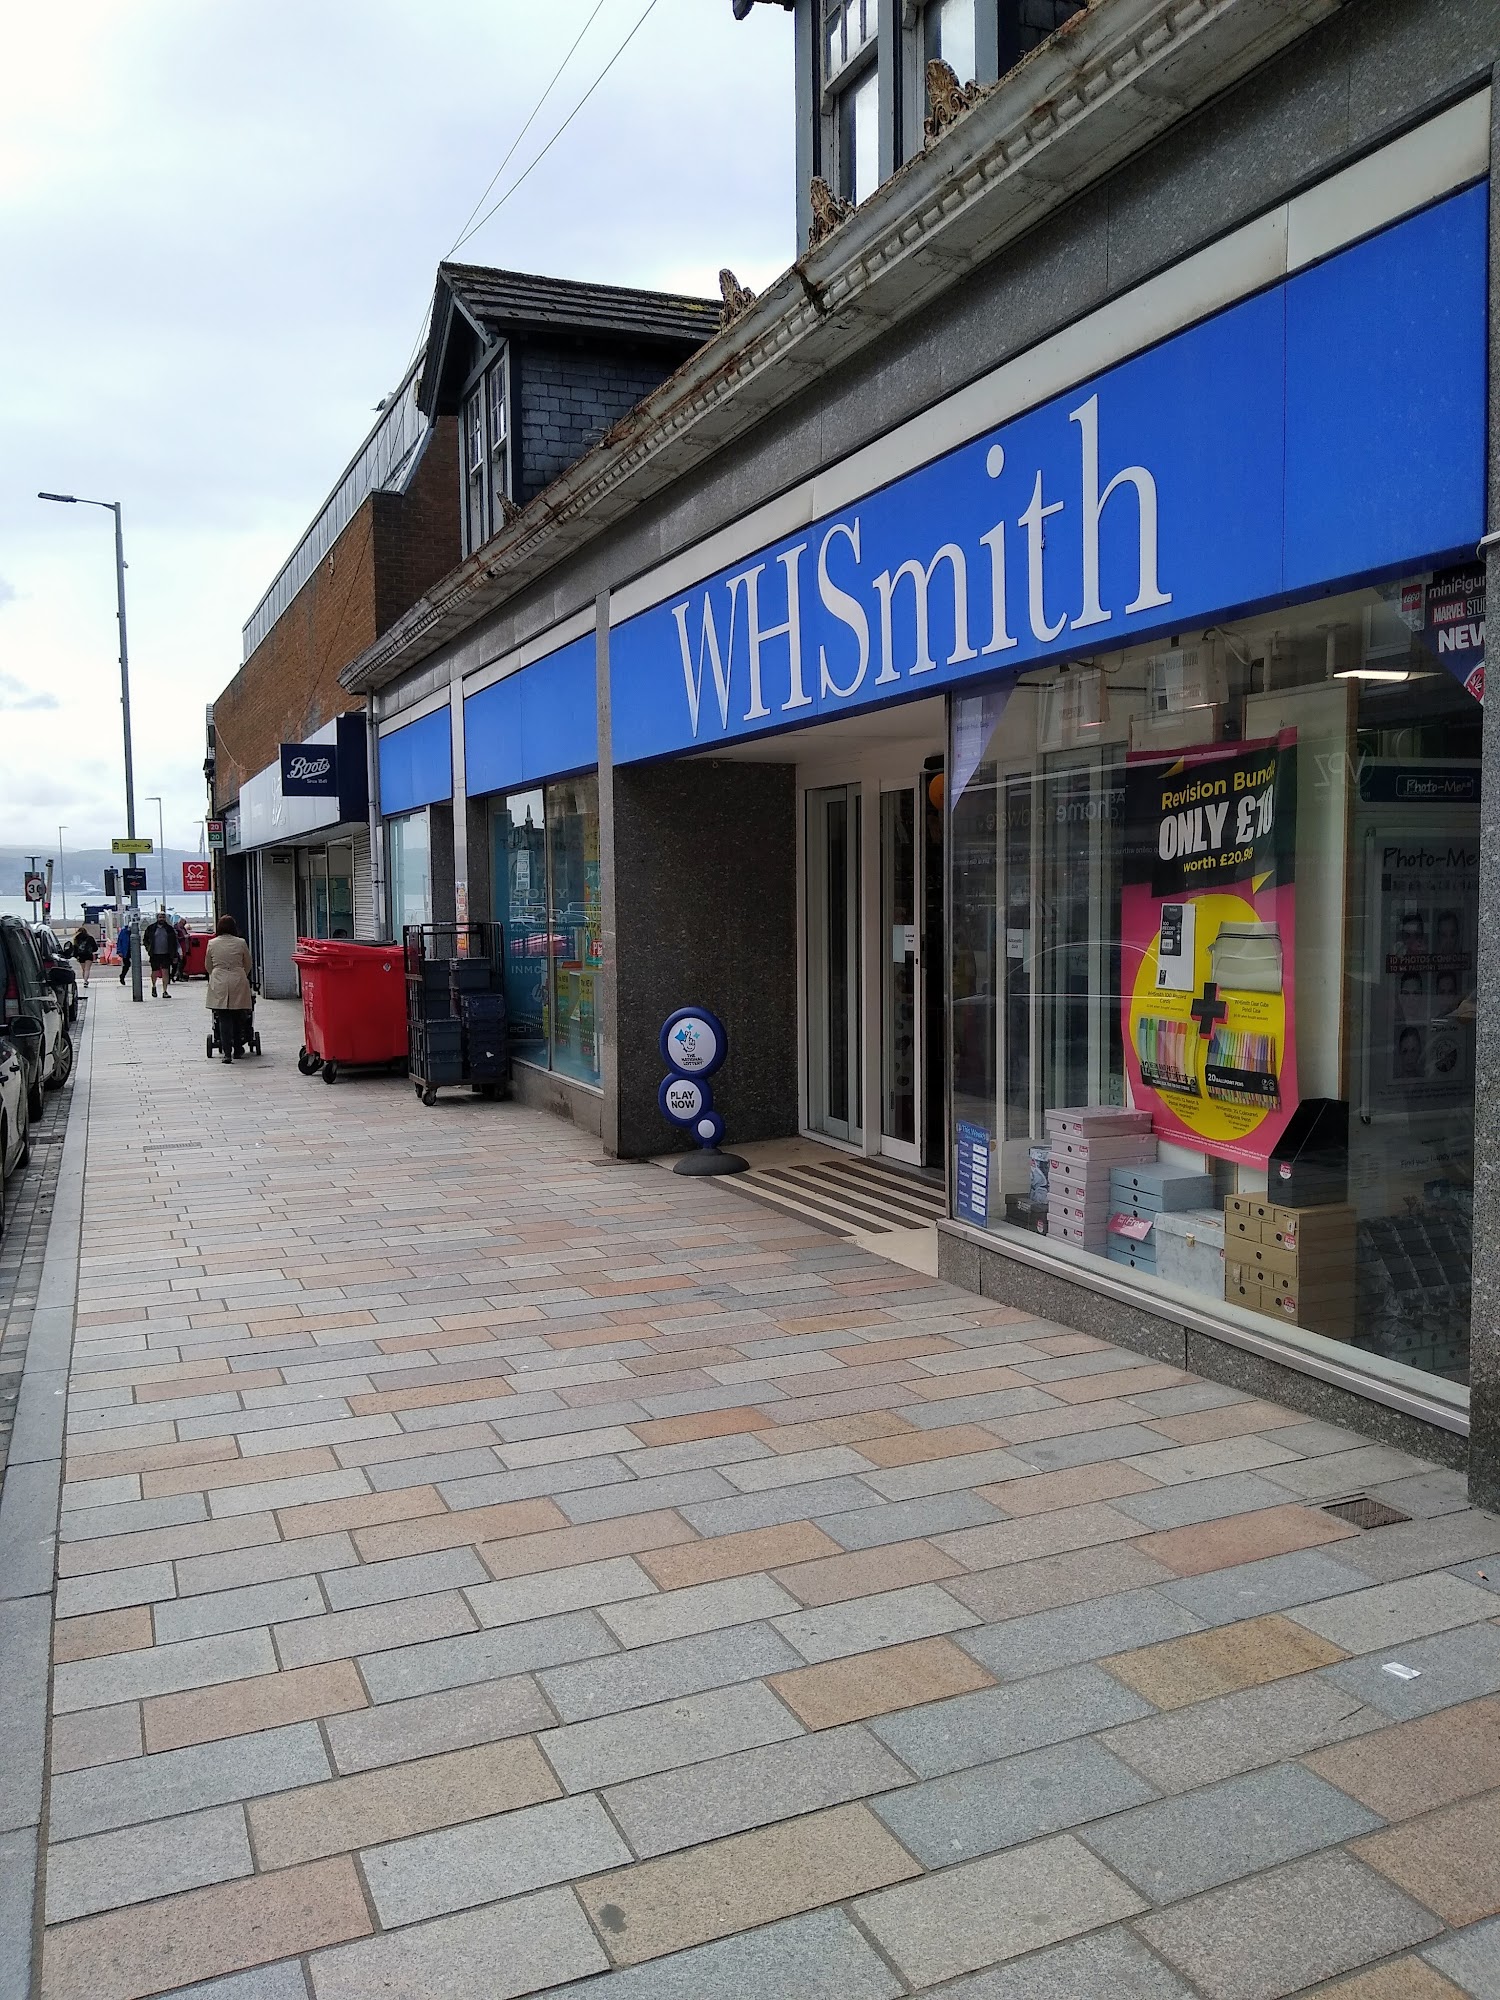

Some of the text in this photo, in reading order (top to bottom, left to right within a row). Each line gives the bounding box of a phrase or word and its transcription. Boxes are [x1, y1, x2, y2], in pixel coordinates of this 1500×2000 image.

[672, 394, 1173, 738] WHSmith
[1403, 592, 1420, 604] LEGO
[1434, 601, 1465, 622] MARVEL
[287, 757, 330, 779] Boots
[1162, 779, 1227, 810] Revision
[1159, 783, 1274, 861] ONLY £10
[1183, 847, 1254, 872] worth £20.98
[1384, 848, 1478, 868] Photo-Me
[1400, 955, 1430, 964] PHOTOS
[1207, 1073, 1216, 1082] 20
[670, 1091, 694, 1100] PLAY
[671, 1100, 695, 1109] NOW
[1126, 1216, 1145, 1229] Free
